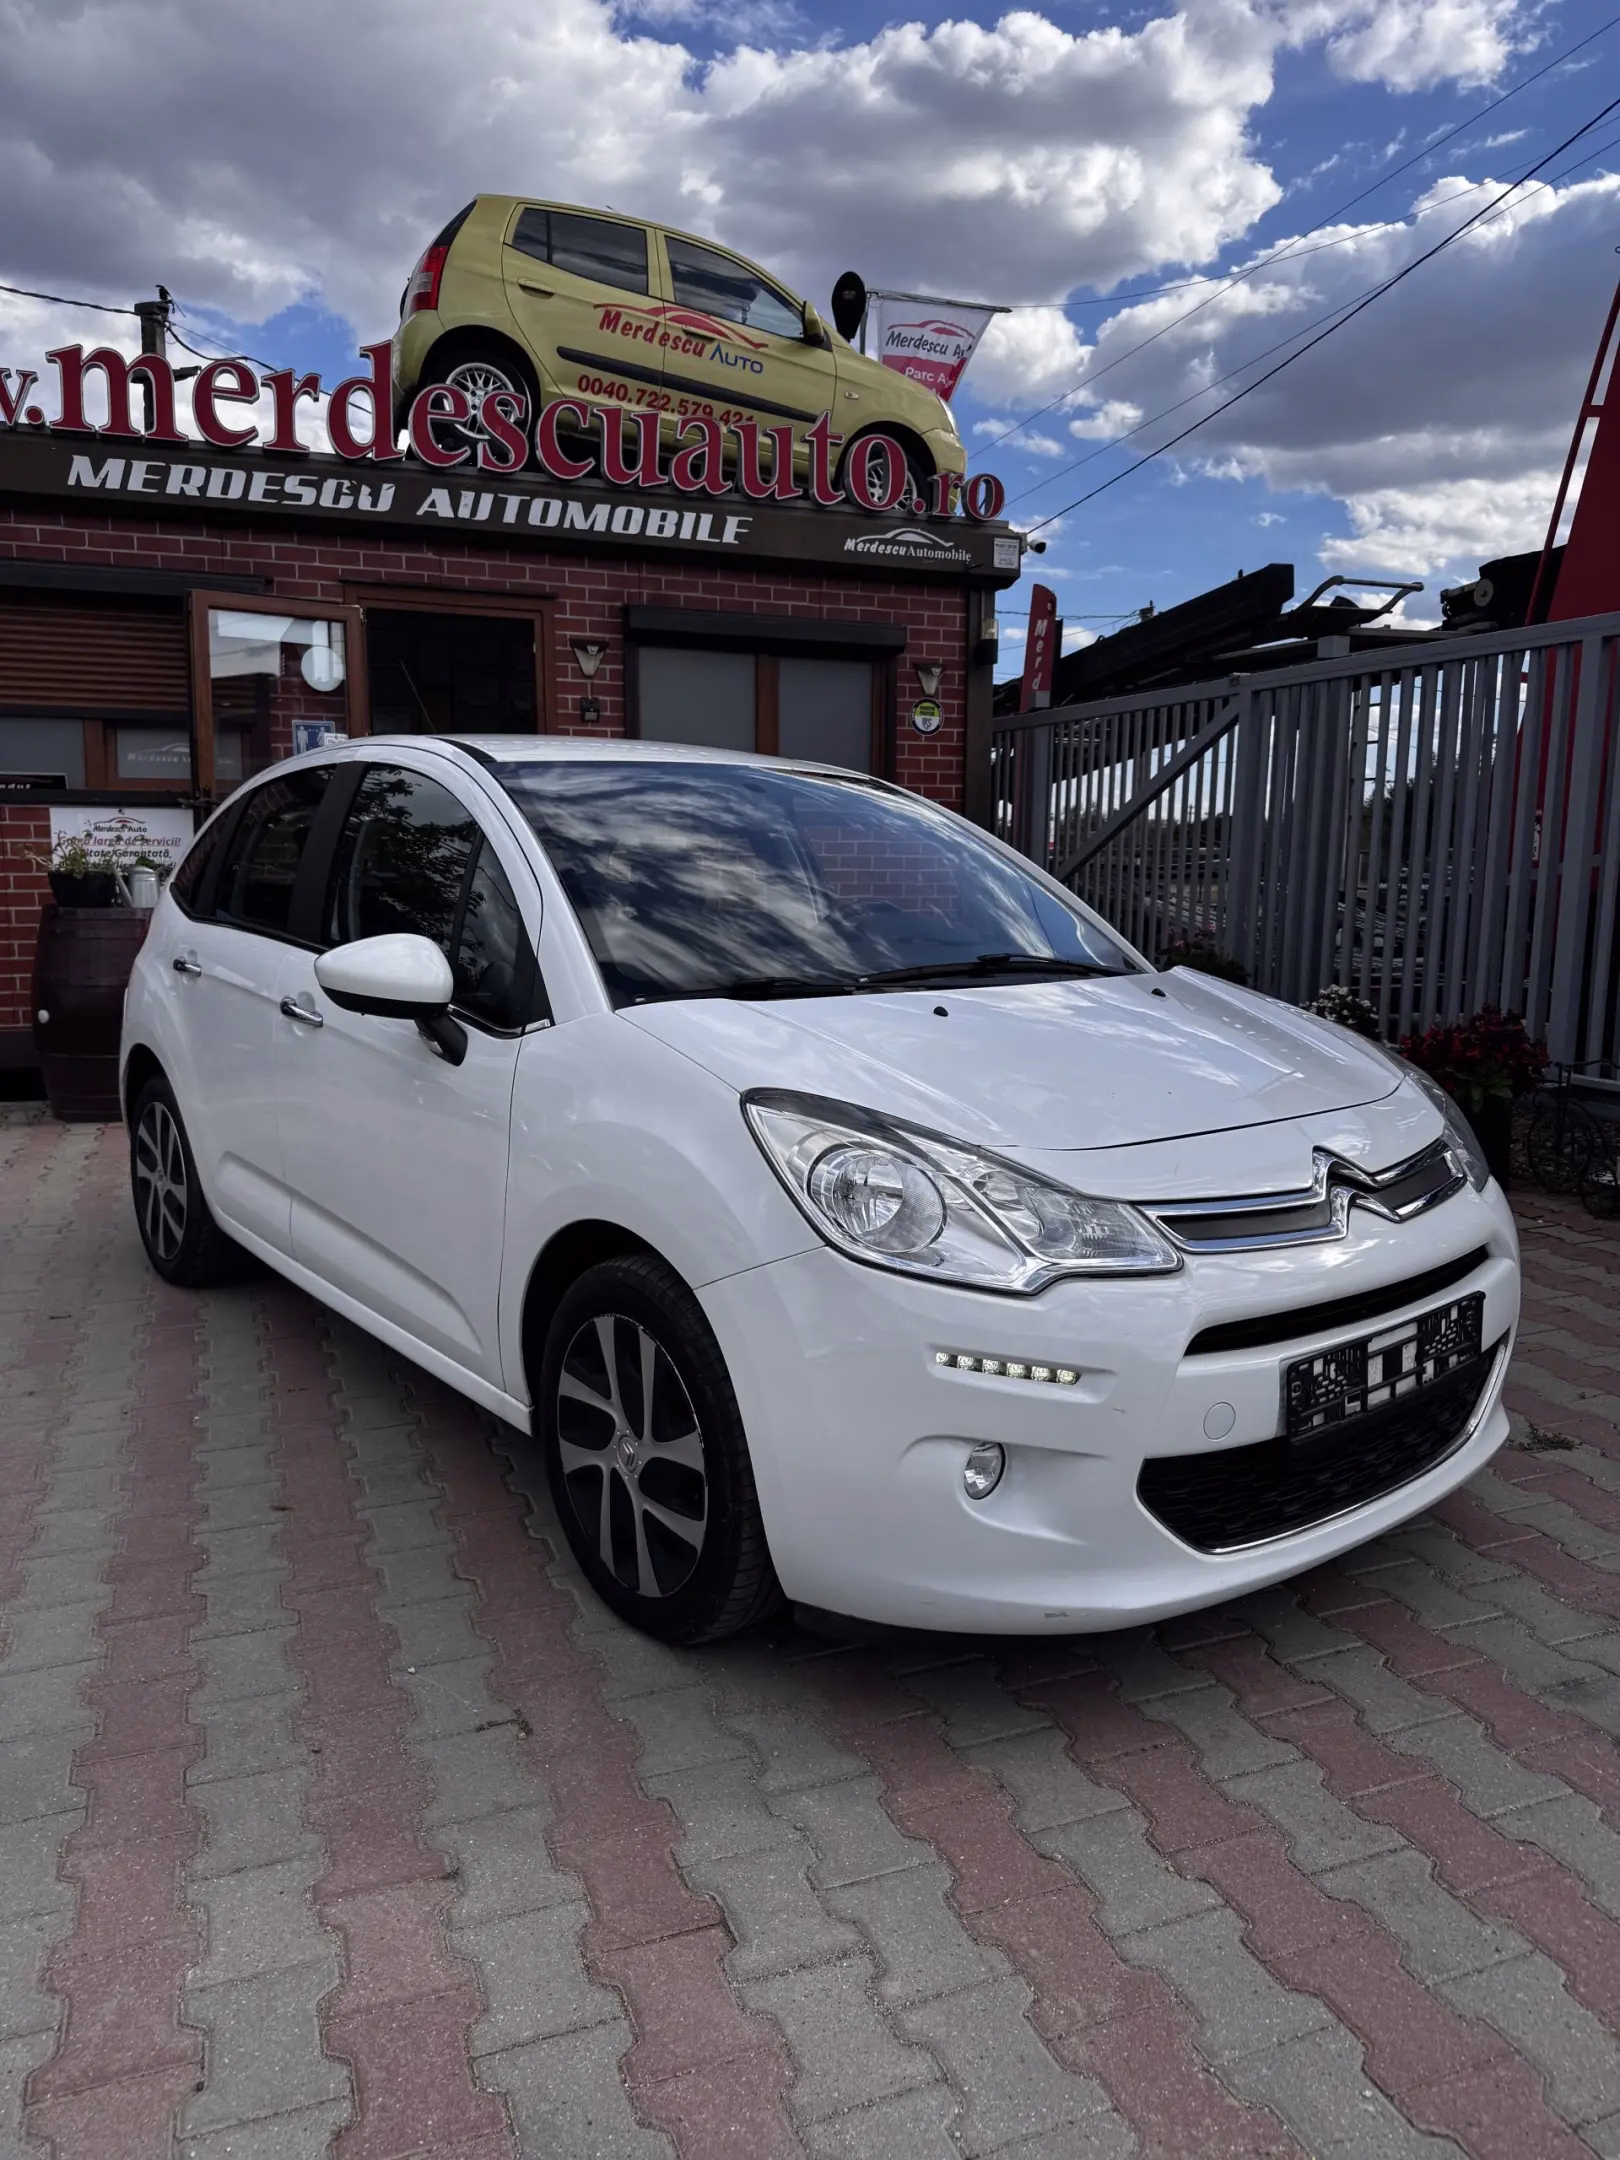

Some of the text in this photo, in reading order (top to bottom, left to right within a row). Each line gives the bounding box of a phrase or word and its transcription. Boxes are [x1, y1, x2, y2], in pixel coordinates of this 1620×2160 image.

[598, 309, 764, 374] Merdescu AUTO
[885, 330, 948, 356] Merdescu
[904, 366, 935, 382] Parc
[577, 374, 755, 426] 0040.722.57942
[67, 454, 754, 544] MERDESCU AUTOMOBILE
[843, 537, 972, 562] Merdescu Automobile
[127, 825, 148, 833] Auto
